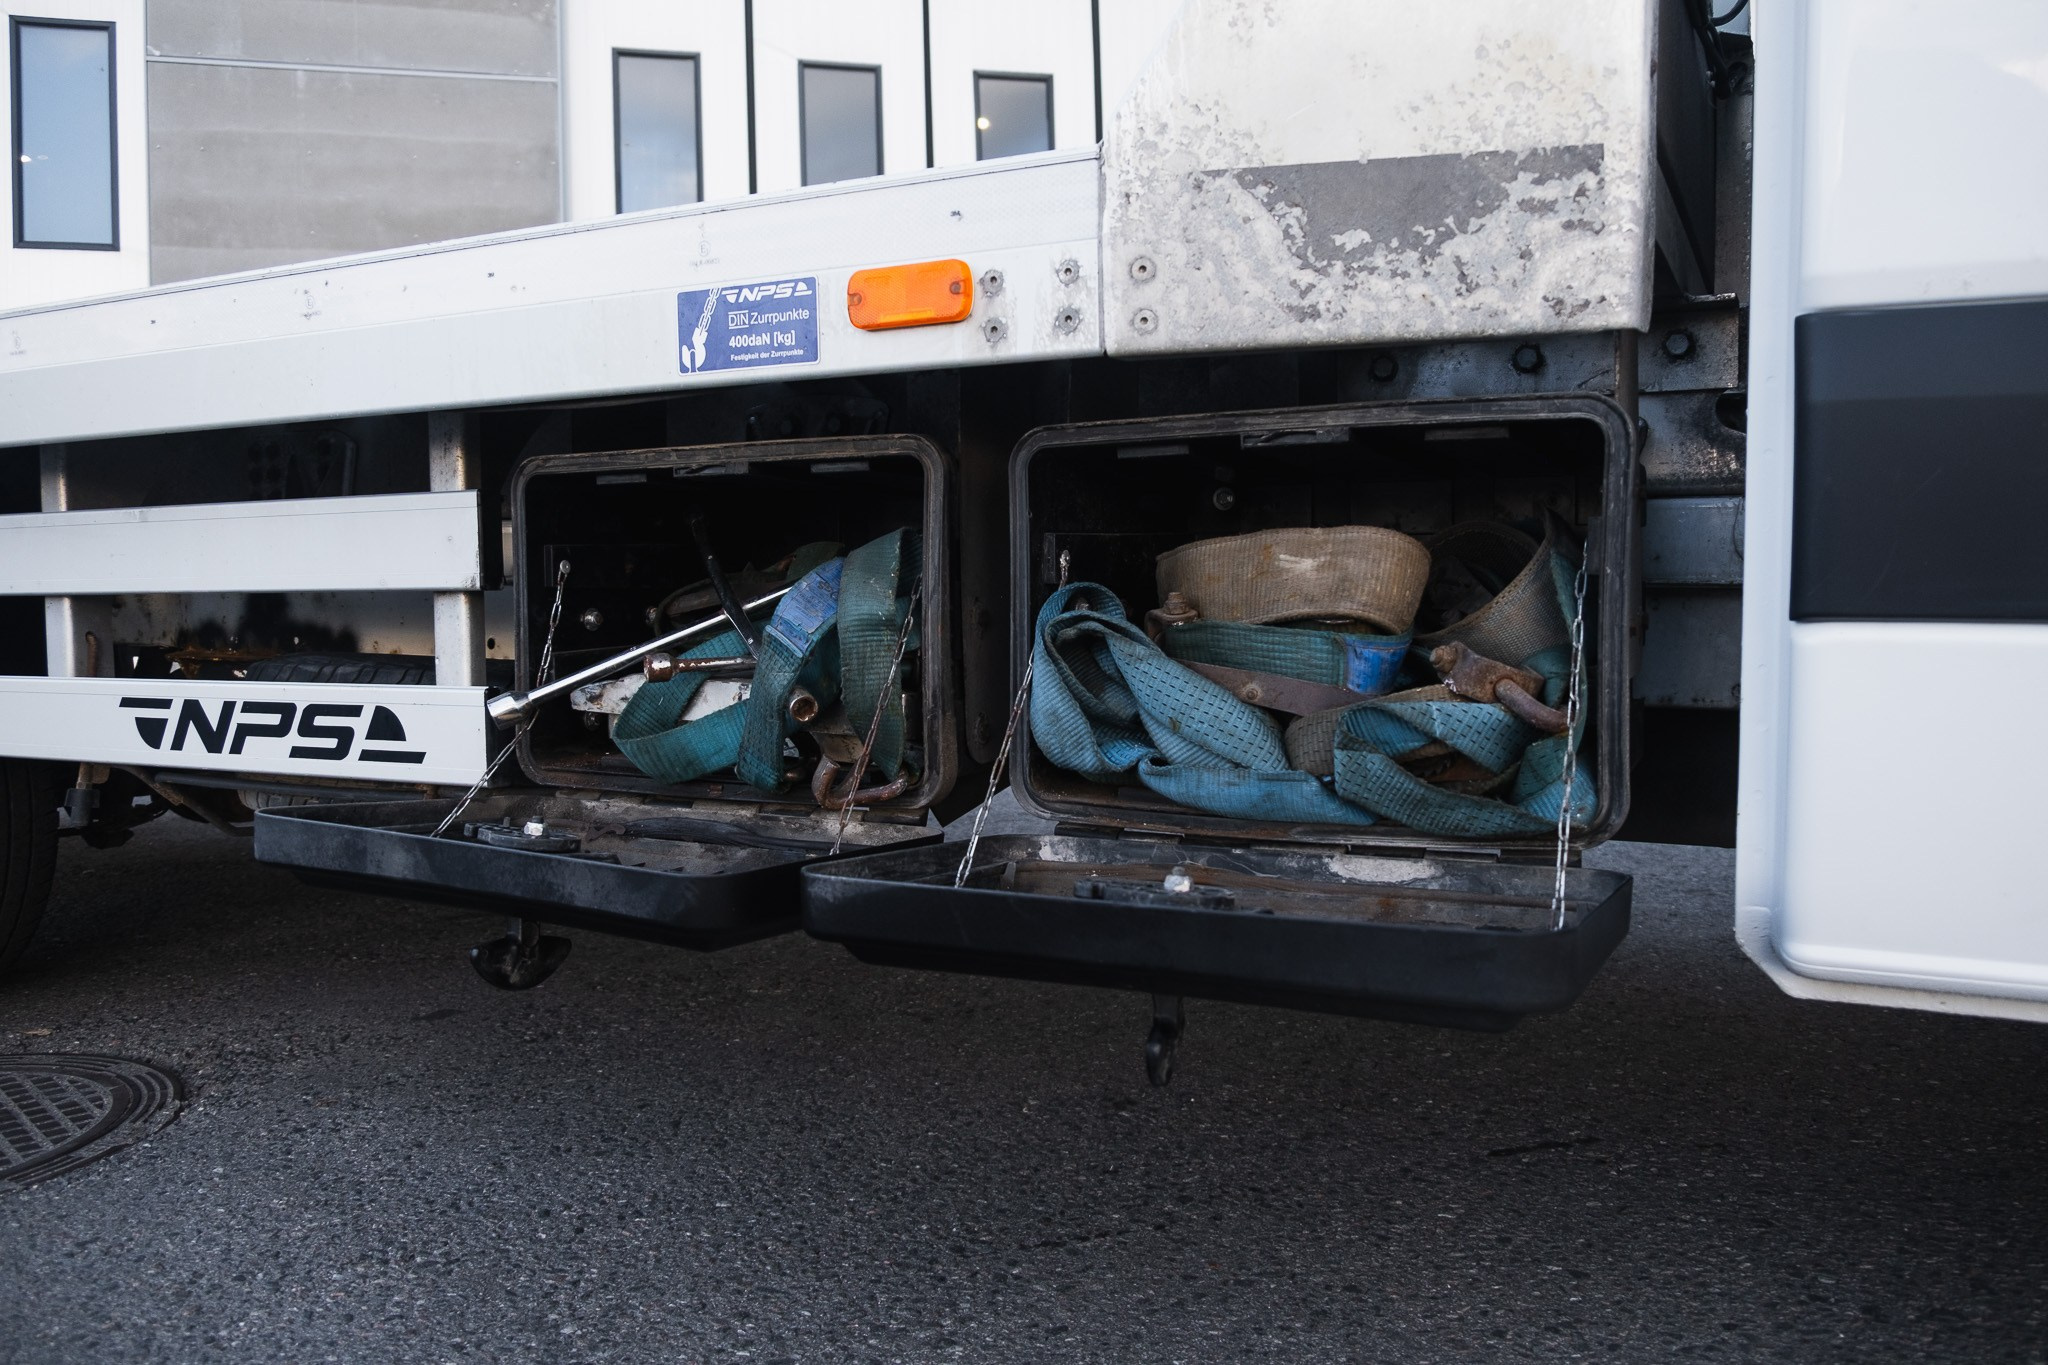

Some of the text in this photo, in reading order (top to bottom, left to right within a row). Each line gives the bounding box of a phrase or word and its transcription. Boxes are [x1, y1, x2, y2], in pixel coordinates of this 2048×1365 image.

[738, 283, 795, 303] NPS
[728, 308, 810, 327] DIN Zurrpunkte
[729, 330, 795, 348] 400daN [kg]
[730, 349, 804, 361] Festigkeit der Zurrpunkte
[170, 698, 364, 760] NPS
